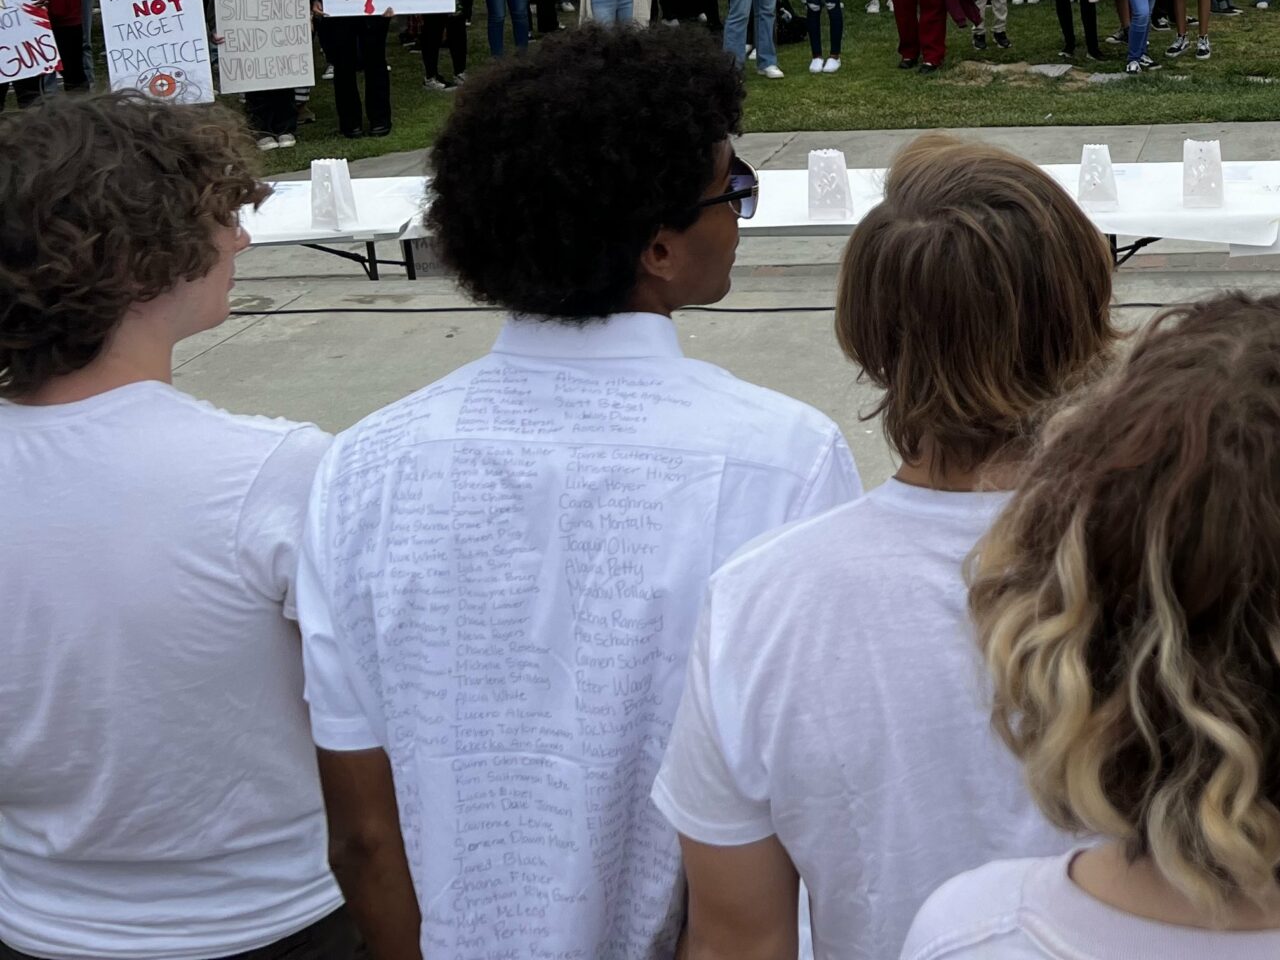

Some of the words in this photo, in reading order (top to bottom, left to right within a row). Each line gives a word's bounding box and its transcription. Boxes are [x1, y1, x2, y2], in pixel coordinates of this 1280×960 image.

[114, 13, 184, 41] TARGET
[224, 28, 268, 53] END
[270, 23, 309, 47] GUN
[0, 34, 57, 78] GUNS
[109, 38, 207, 73] PRACTICE
[219, 52, 309, 81] VIOLENCE
[646, 466, 687, 481] Hixon
[558, 493, 594, 509] Cara
[558, 513, 594, 533] Gina
[607, 536, 660, 555] Oliver
[607, 557, 644, 585] Petty
[452, 856, 492, 876] Jared
[503, 852, 548, 867] Black
[452, 890, 518, 912] Christian
[496, 903, 546, 919] McLeod
[492, 920, 550, 941] Perkins
